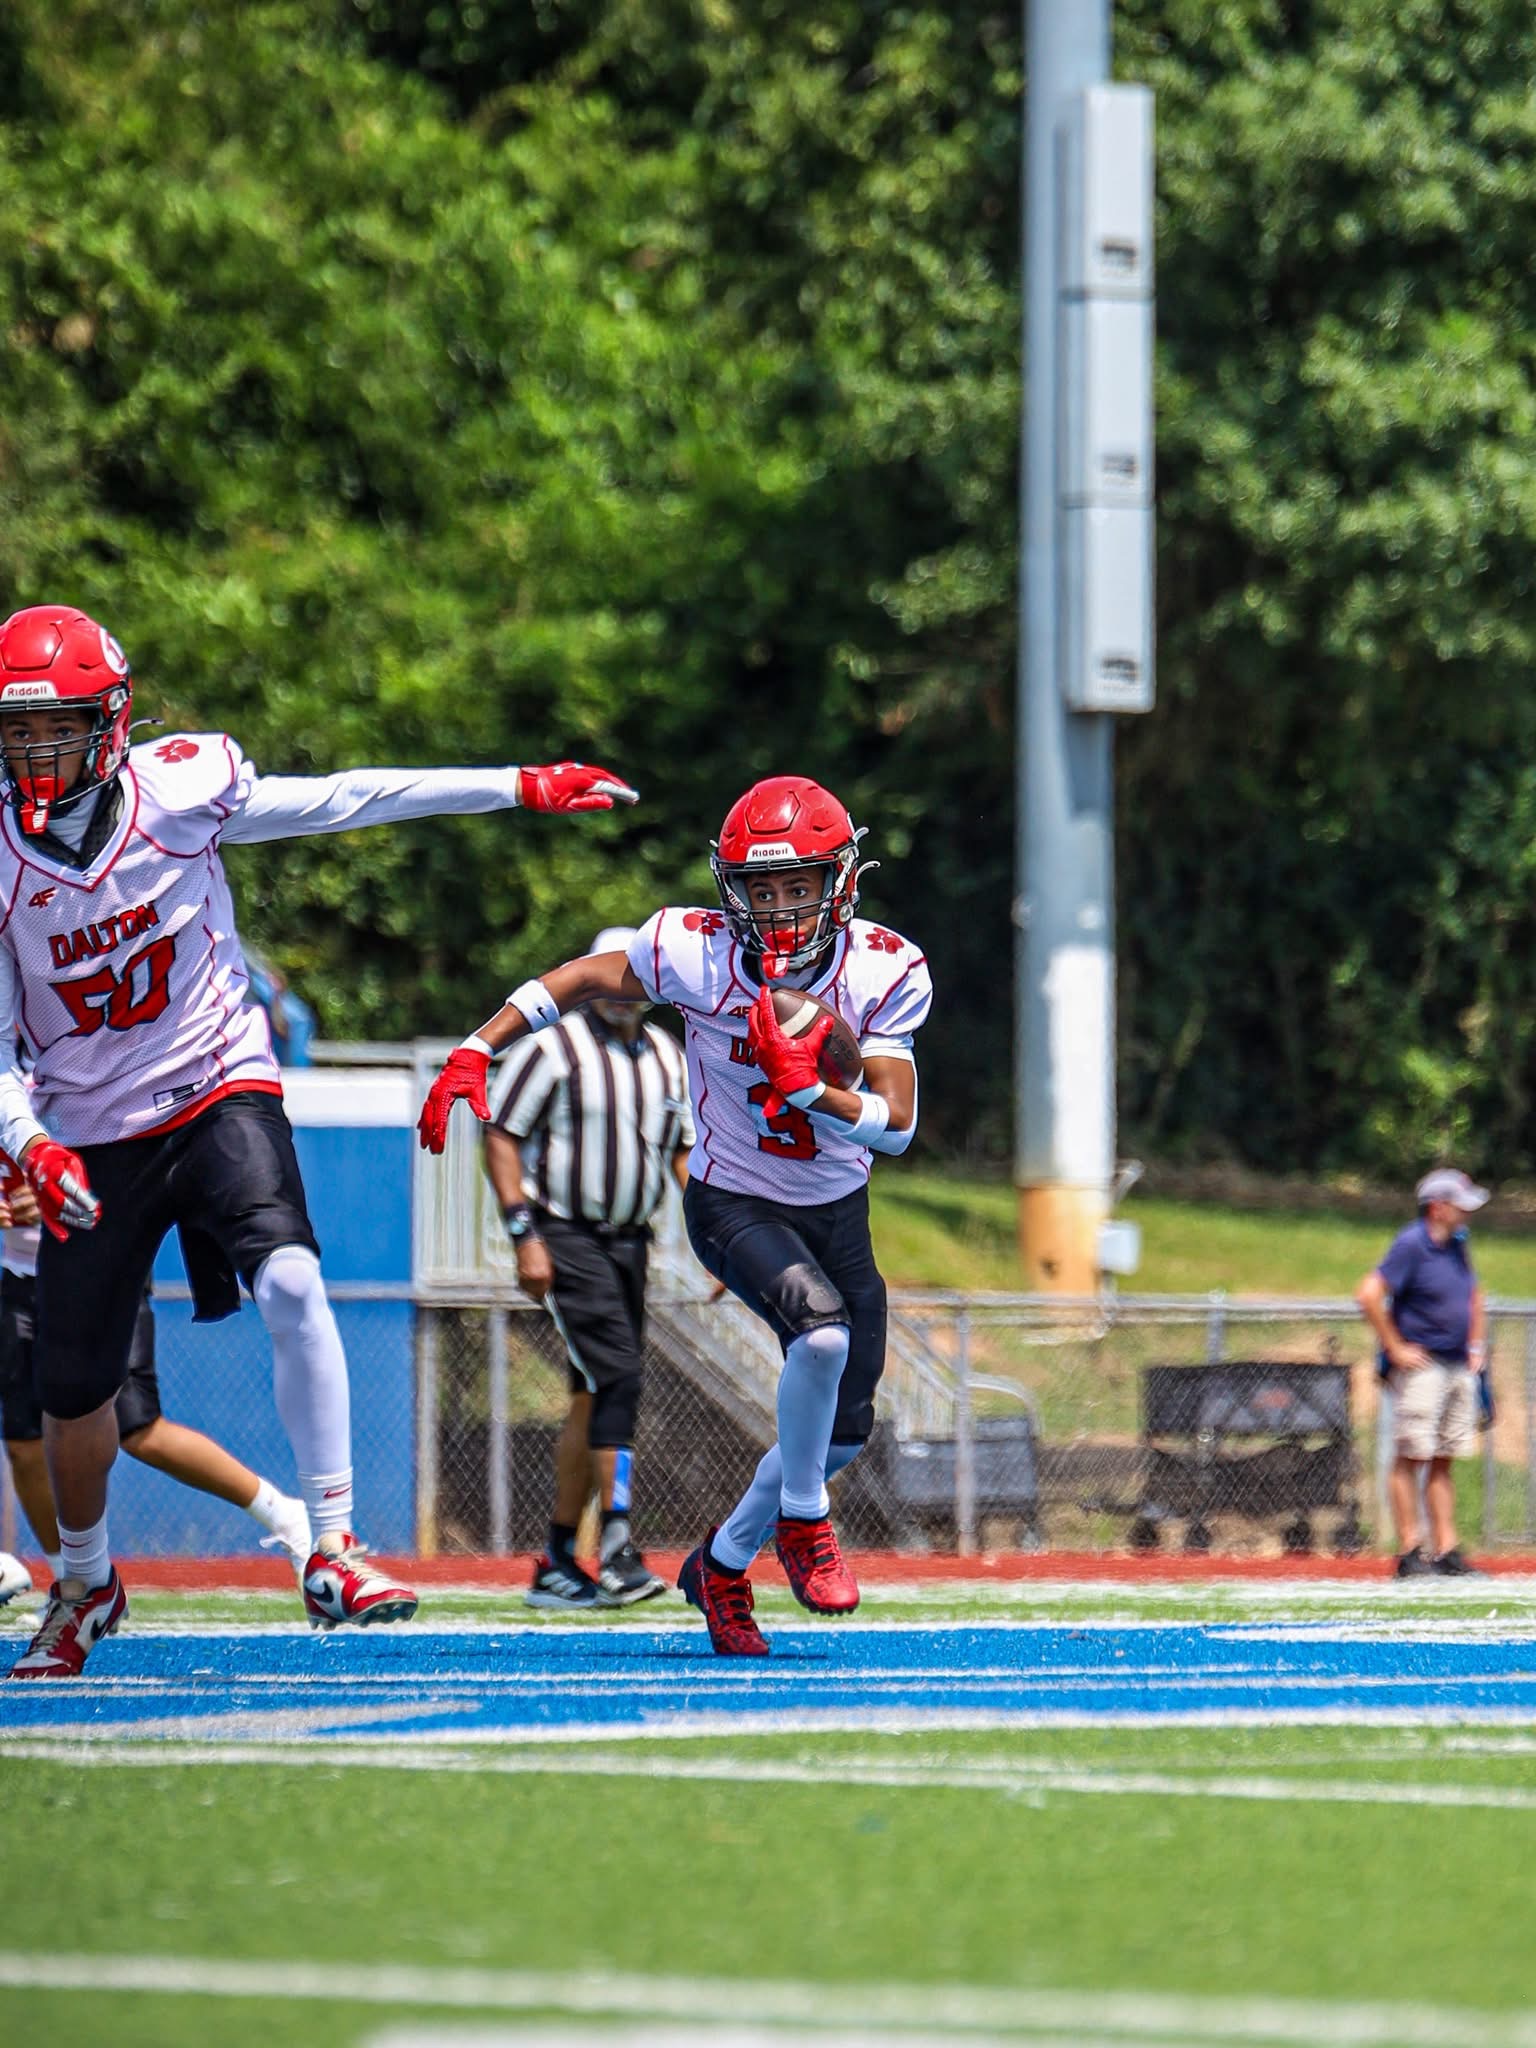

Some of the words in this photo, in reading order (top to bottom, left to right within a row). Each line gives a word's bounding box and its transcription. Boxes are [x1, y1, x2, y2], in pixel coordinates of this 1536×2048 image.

[48, 900, 160, 970] DALTON
[48, 933, 178, 1037] 50
[747, 1081, 822, 1161] 3
